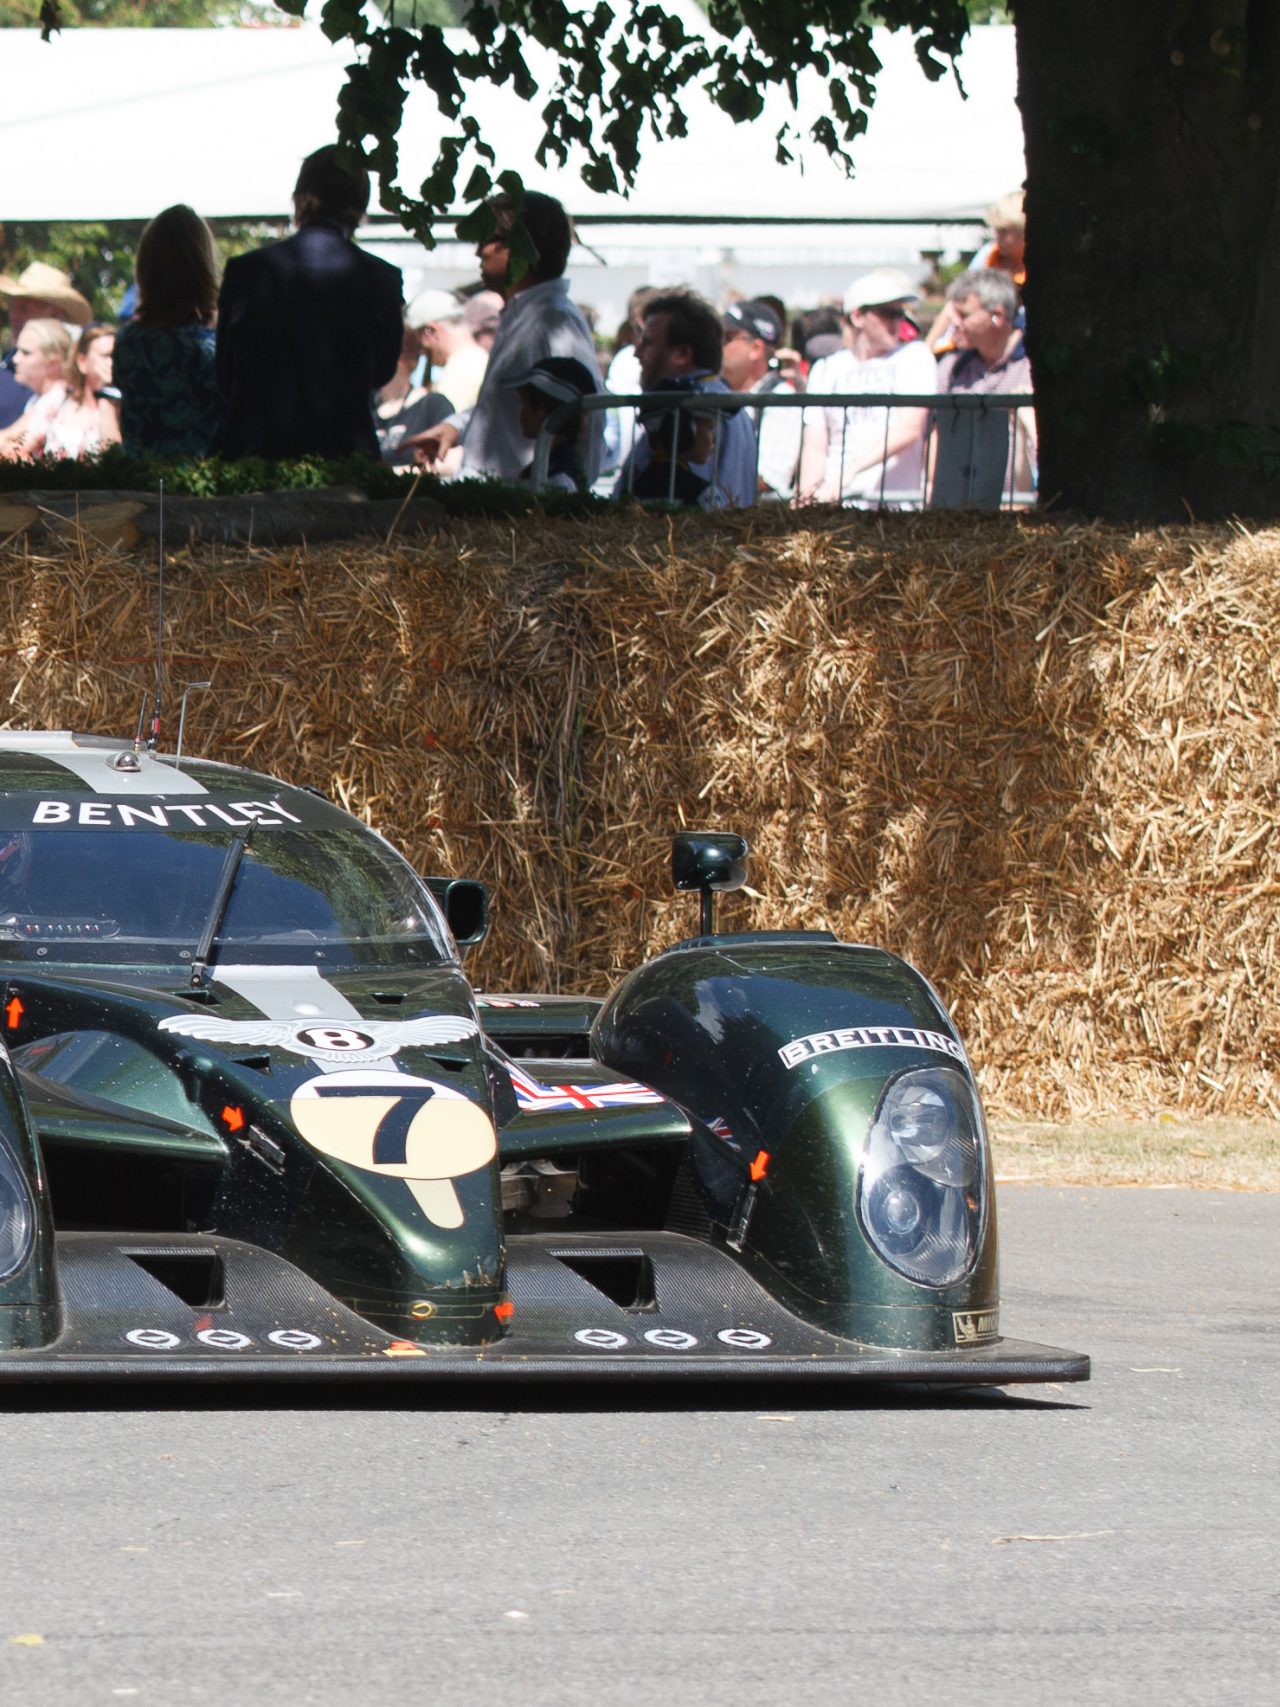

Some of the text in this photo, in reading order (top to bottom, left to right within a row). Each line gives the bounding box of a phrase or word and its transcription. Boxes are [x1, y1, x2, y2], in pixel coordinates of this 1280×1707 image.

[31, 800, 302, 827] BENTLEY
[786, 1028, 963, 1065] BREITLING
[312, 1085, 437, 1165] 7
